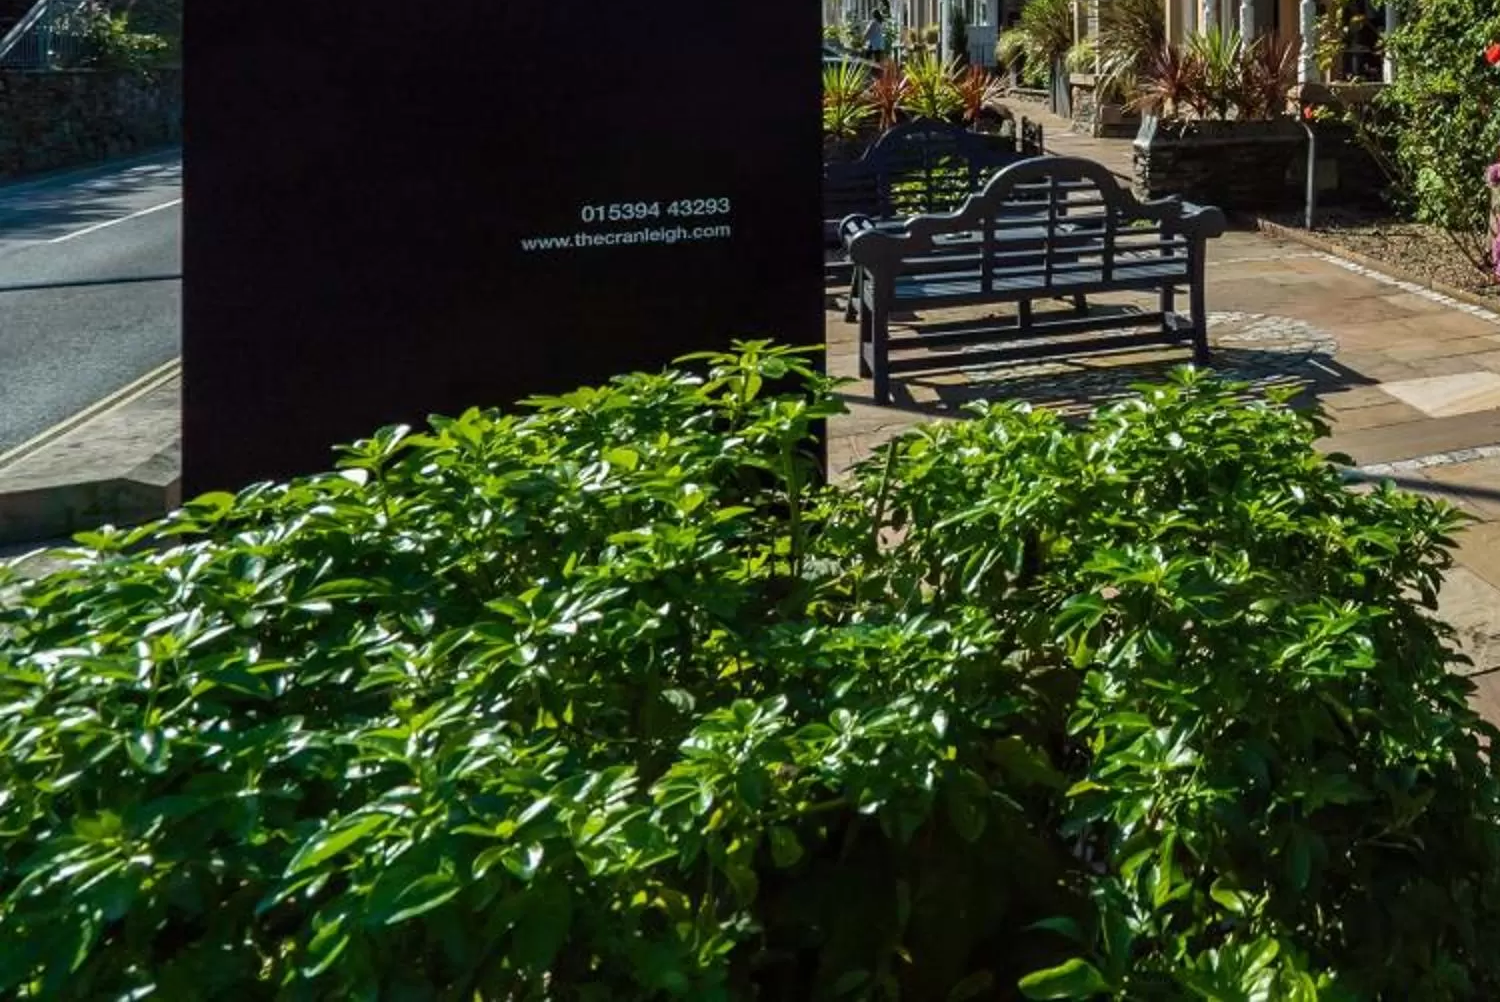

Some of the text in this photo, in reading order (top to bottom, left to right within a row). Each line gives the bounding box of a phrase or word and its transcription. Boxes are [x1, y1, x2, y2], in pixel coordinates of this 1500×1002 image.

[580, 197, 731, 223] 015394 43293
[521, 224, 731, 250] www.thecranleigh.com
